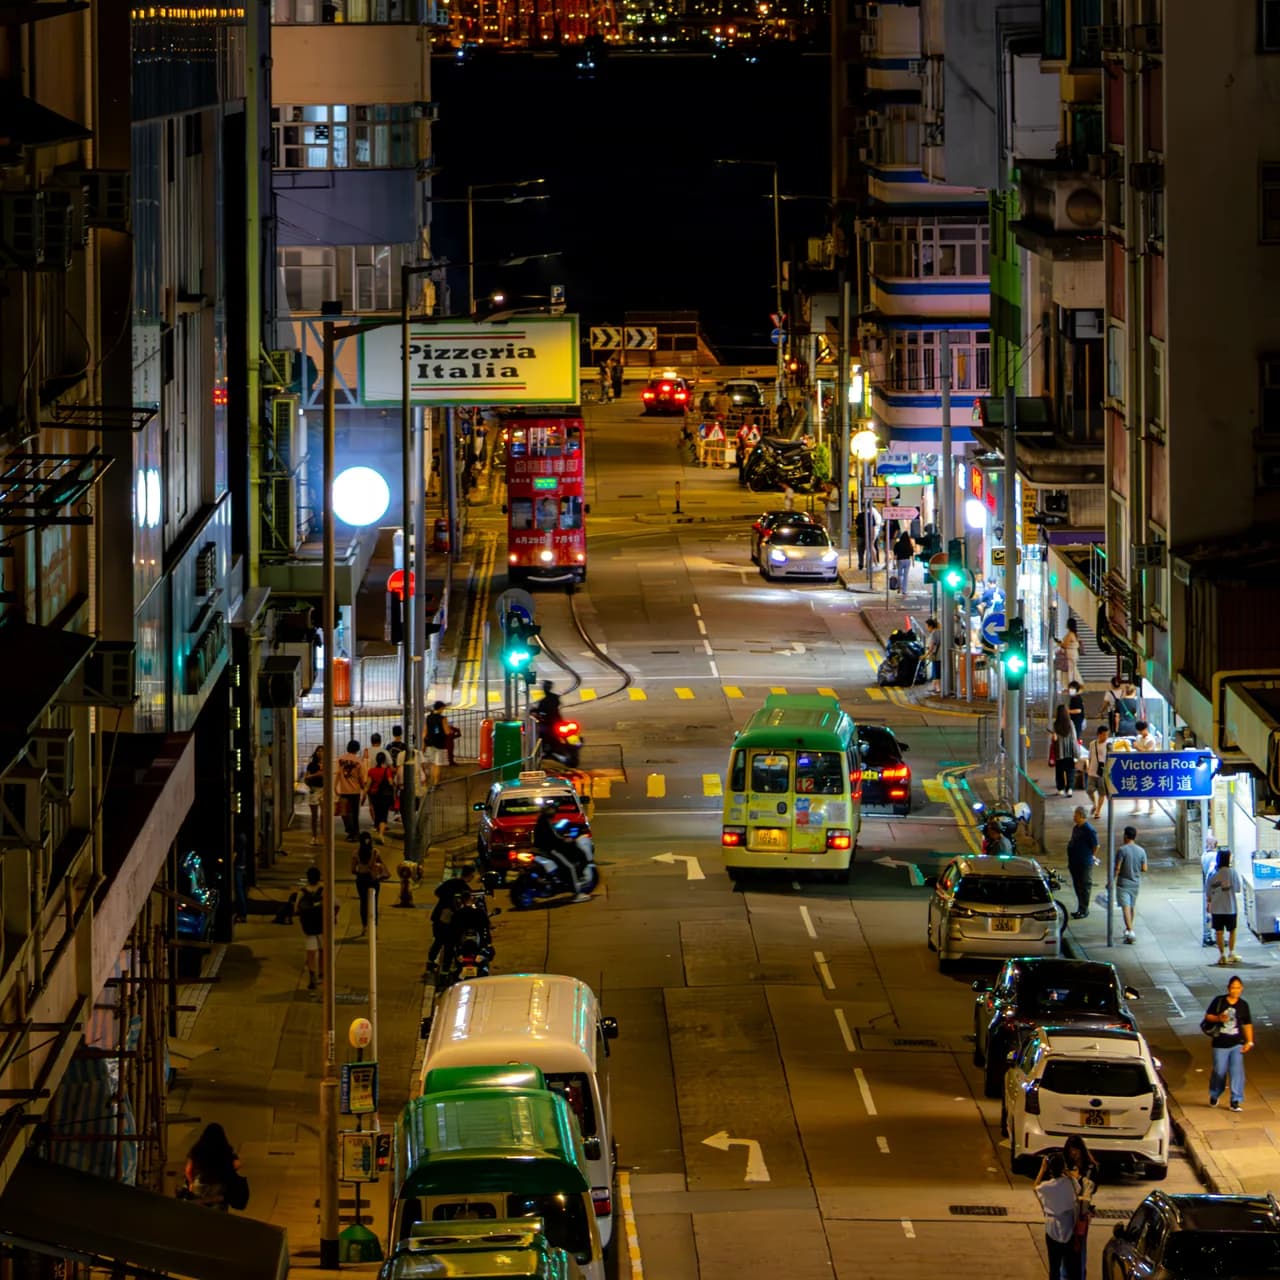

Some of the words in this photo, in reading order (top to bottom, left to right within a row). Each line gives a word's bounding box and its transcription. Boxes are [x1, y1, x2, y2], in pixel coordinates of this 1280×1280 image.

[400, 343, 536, 360] Pizzeria
[417, 363, 519, 378] Italia
[1120, 759, 1169, 771] Victoria
[1170, 758, 1200, 769] Roa
[796, 778, 815, 792] 12
[1120, 775, 1192, 791] 域多利道
